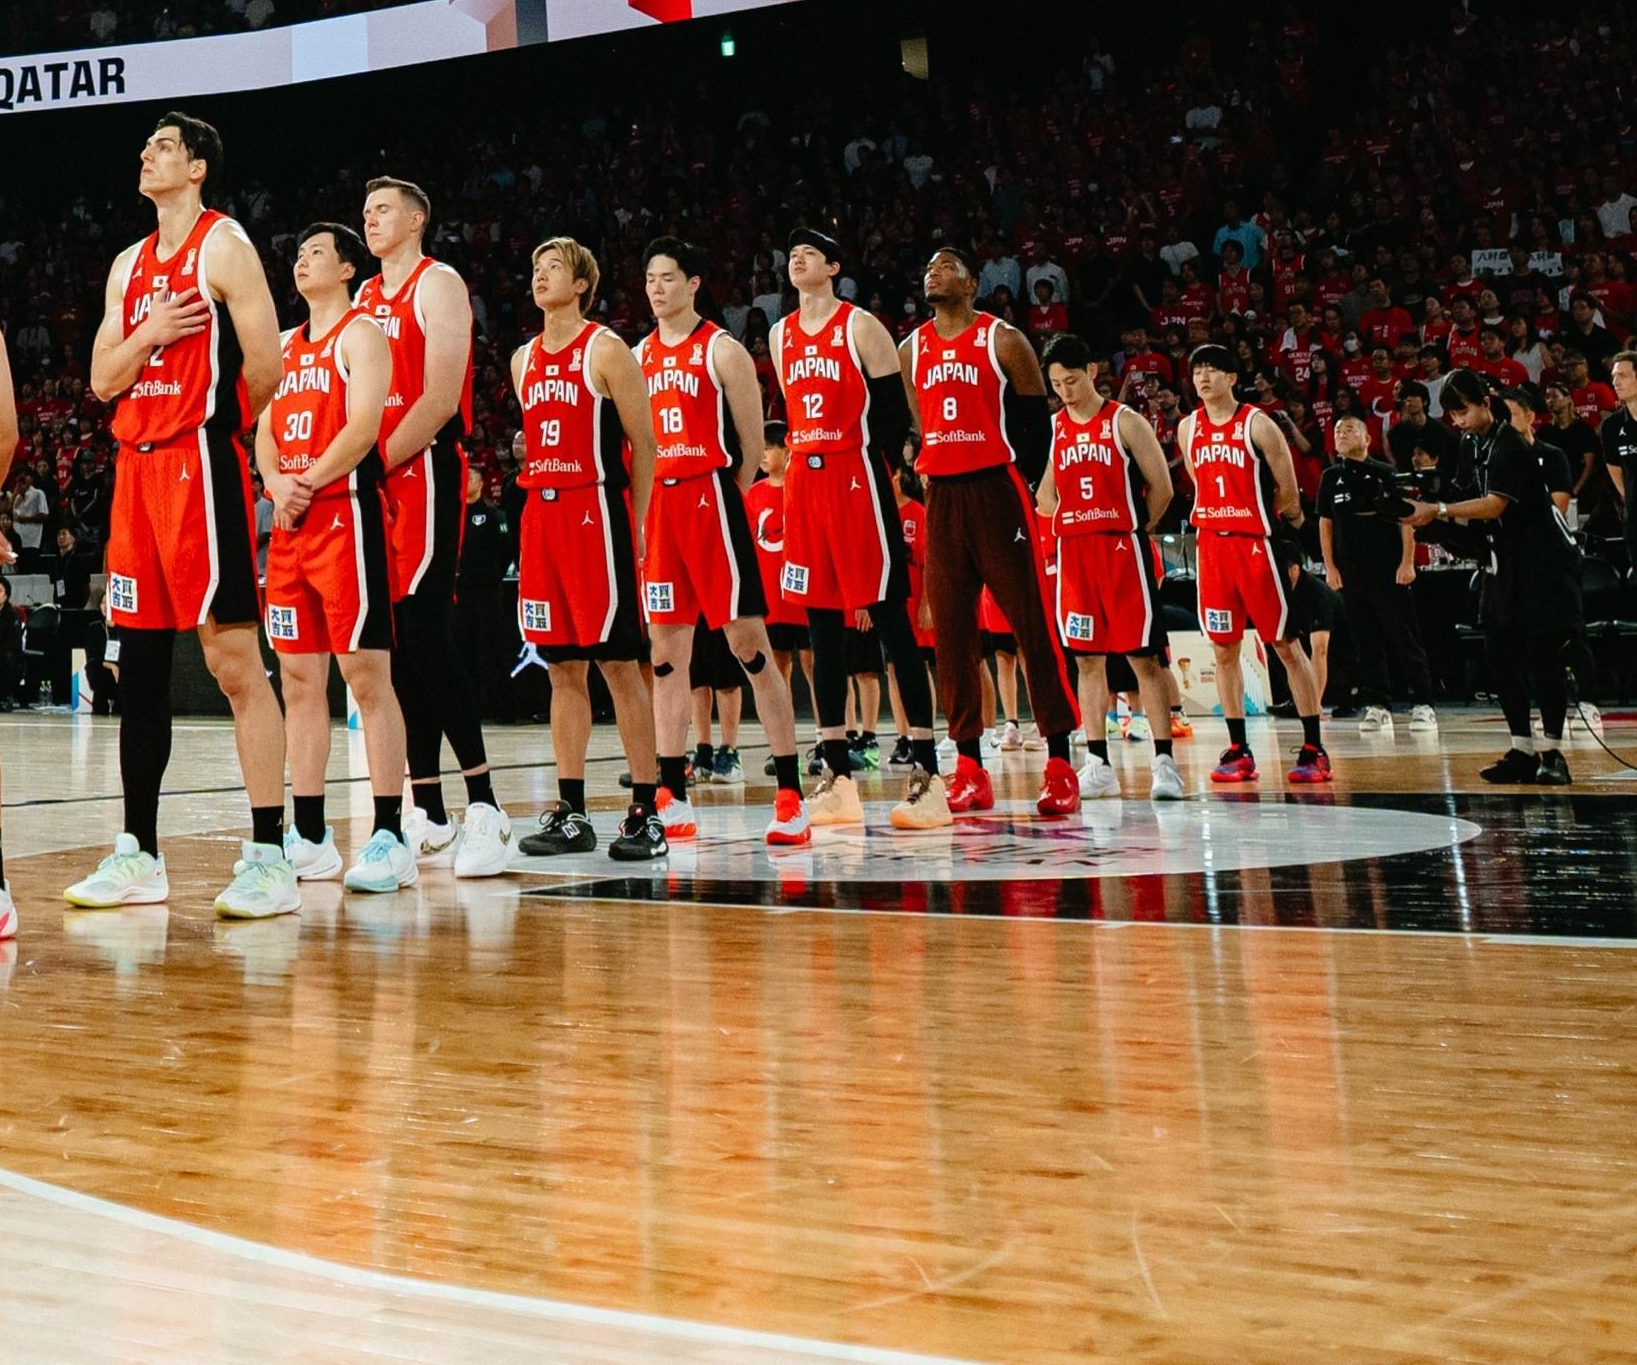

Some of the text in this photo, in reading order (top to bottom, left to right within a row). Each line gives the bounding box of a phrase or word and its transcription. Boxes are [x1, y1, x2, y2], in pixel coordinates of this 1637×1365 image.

[274, 366, 330, 401] JAPAN
[648, 369, 699, 398] JAPAN
[786, 357, 840, 385] JAPAN
[922, 363, 978, 390] JAPAN
[524, 379, 578, 410] JAPAN
[802, 393, 823, 419] 12
[659, 407, 683, 434] 18
[943, 397, 957, 421] 8
[283, 411, 312, 442] 30
[539, 419, 561, 446] 19
[799, 427, 843, 442] SoftBank
[936, 429, 986, 443] SoftBank
[280, 453, 319, 470] SoftBa
[656, 443, 707, 458] SoftBank
[1059, 443, 1111, 471] JAPAN
[1194, 445, 1245, 469] JAPAN
[1079, 476, 1093, 500] 5
[1214, 475, 1226, 498] 1
[1074, 507, 1120, 522] SoftBank
[1207, 506, 1253, 519] SoftBank
